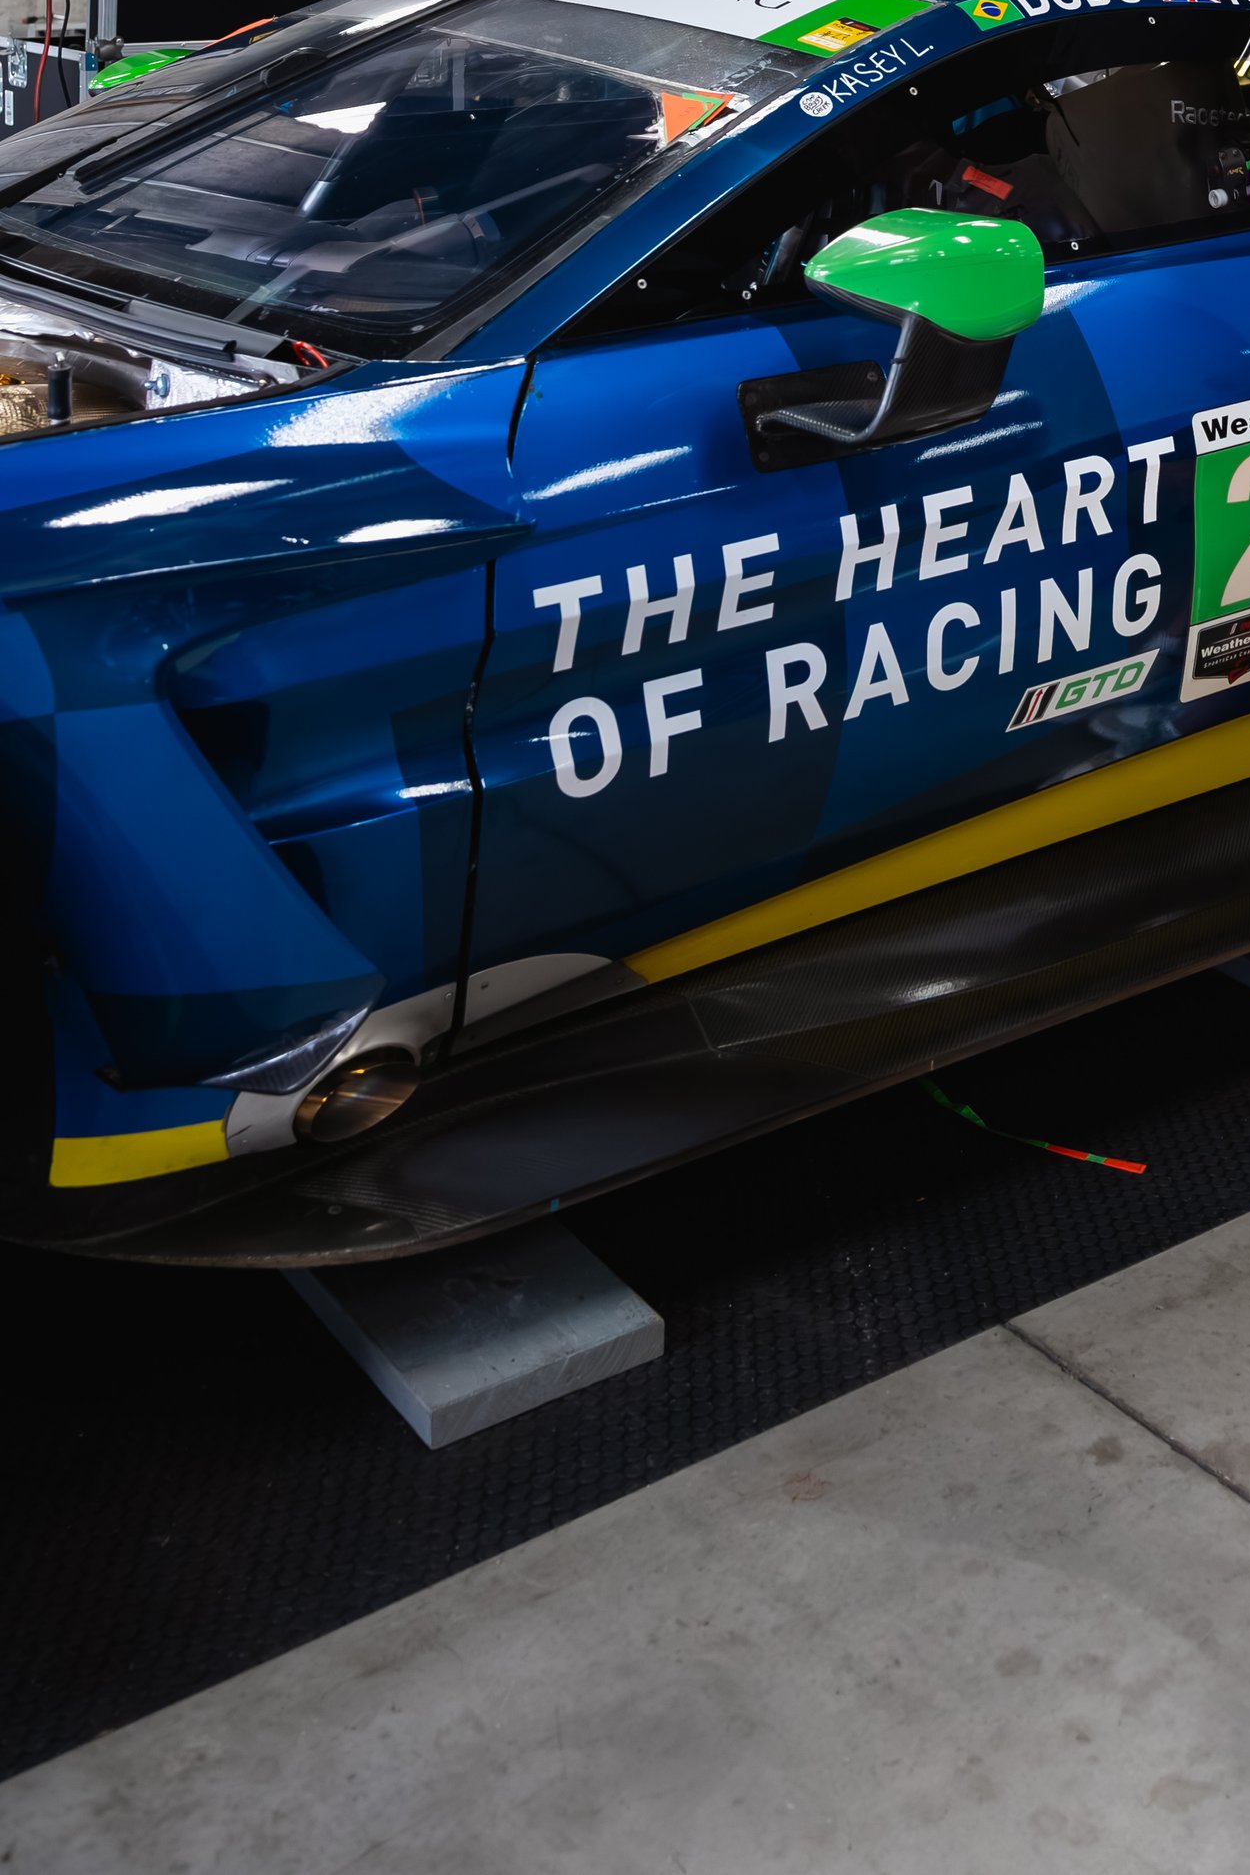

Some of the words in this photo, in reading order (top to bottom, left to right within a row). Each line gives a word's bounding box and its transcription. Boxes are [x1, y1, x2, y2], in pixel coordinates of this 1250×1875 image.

[822, 44, 906, 103] KASEY
[900, 38, 934, 57] L.
[532, 532, 780, 673] THE
[834, 436, 1175, 602] HEART
[549, 668, 703, 799] OF
[765, 553, 1162, 743] RACING
[1055, 660, 1146, 710] GTD
